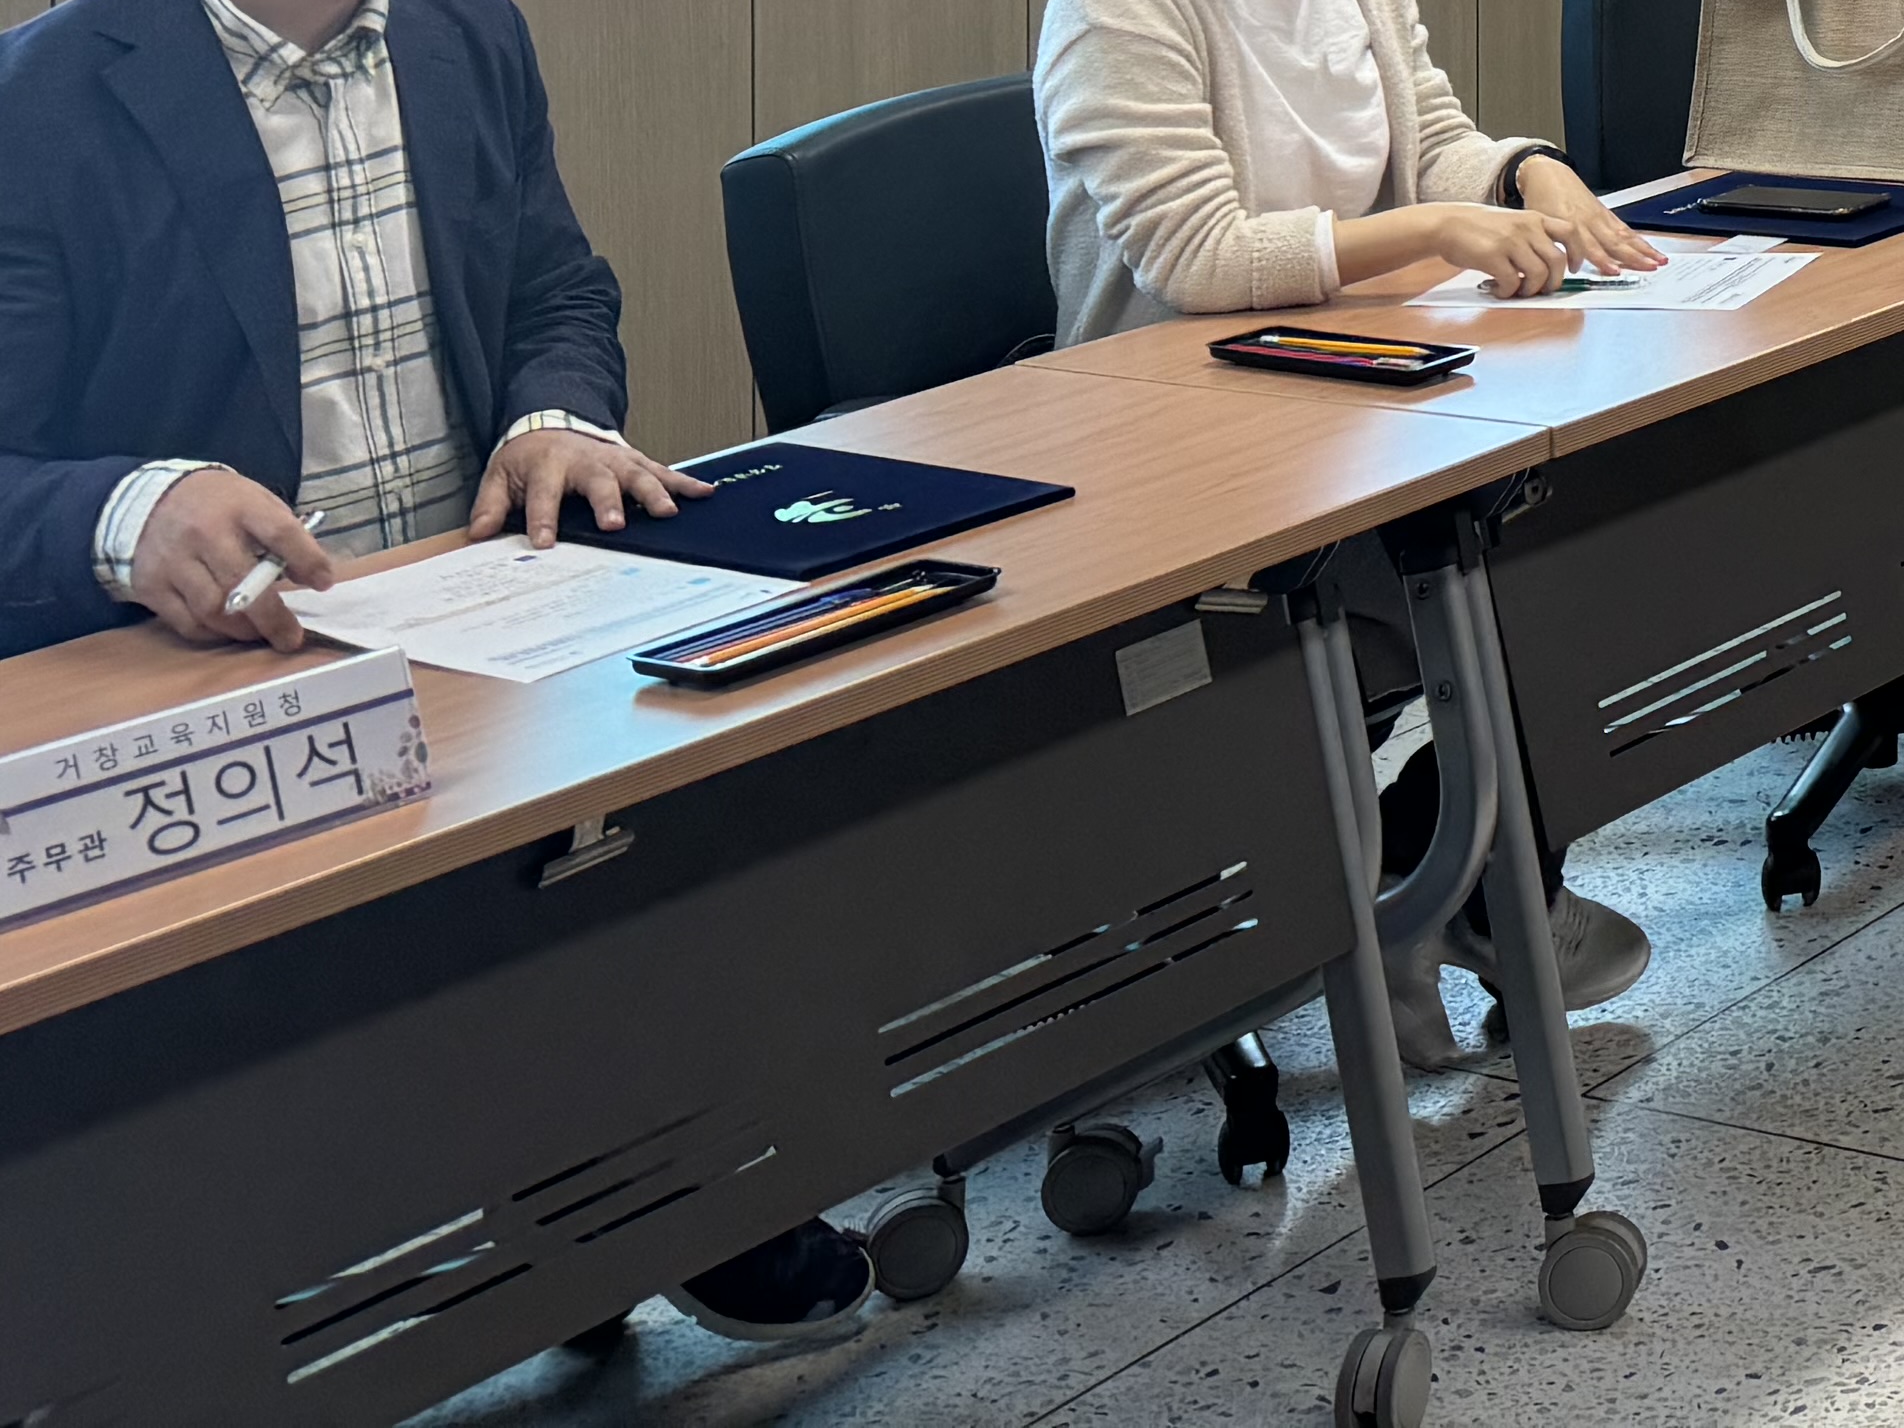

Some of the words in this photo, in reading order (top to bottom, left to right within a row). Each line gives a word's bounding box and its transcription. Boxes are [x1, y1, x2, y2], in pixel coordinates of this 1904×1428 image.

[55, 689, 303, 782] 거창교육지원청
[6, 830, 108, 885] 주무관
[123, 721, 365, 857] 정의석
